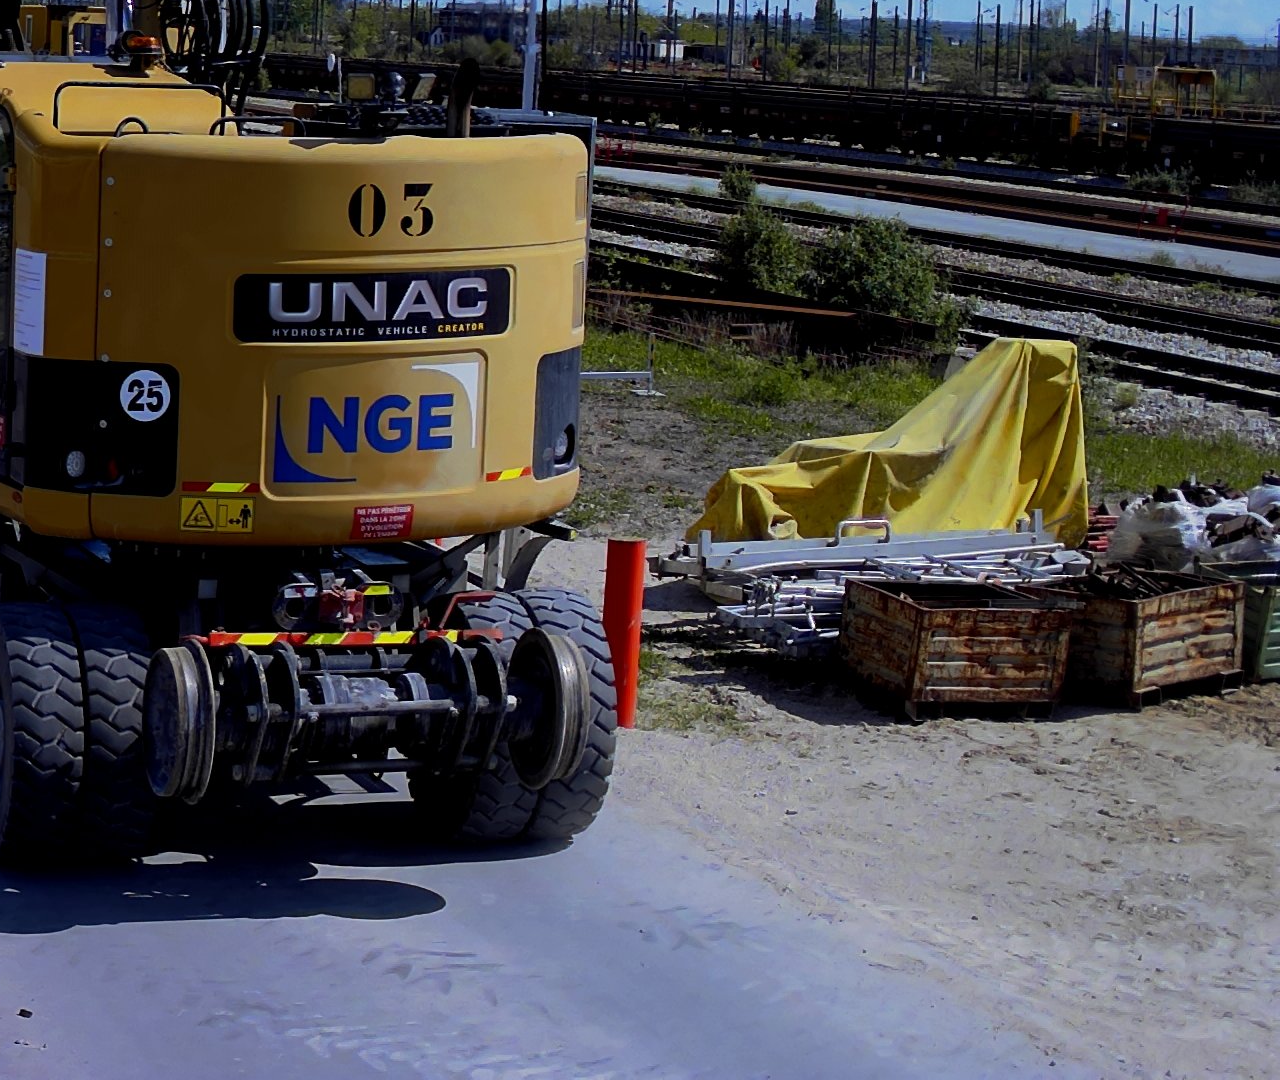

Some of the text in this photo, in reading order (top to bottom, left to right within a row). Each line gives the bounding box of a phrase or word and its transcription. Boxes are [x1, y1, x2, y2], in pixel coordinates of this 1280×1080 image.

[348, 183, 434, 237] 03
[268, 277, 488, 323] UNAC
[272, 322, 484, 337] HYDROSTATIC VEHICLE CREATOR
[127, 379, 164, 412] 25
[307, 393, 454, 454] NGE
